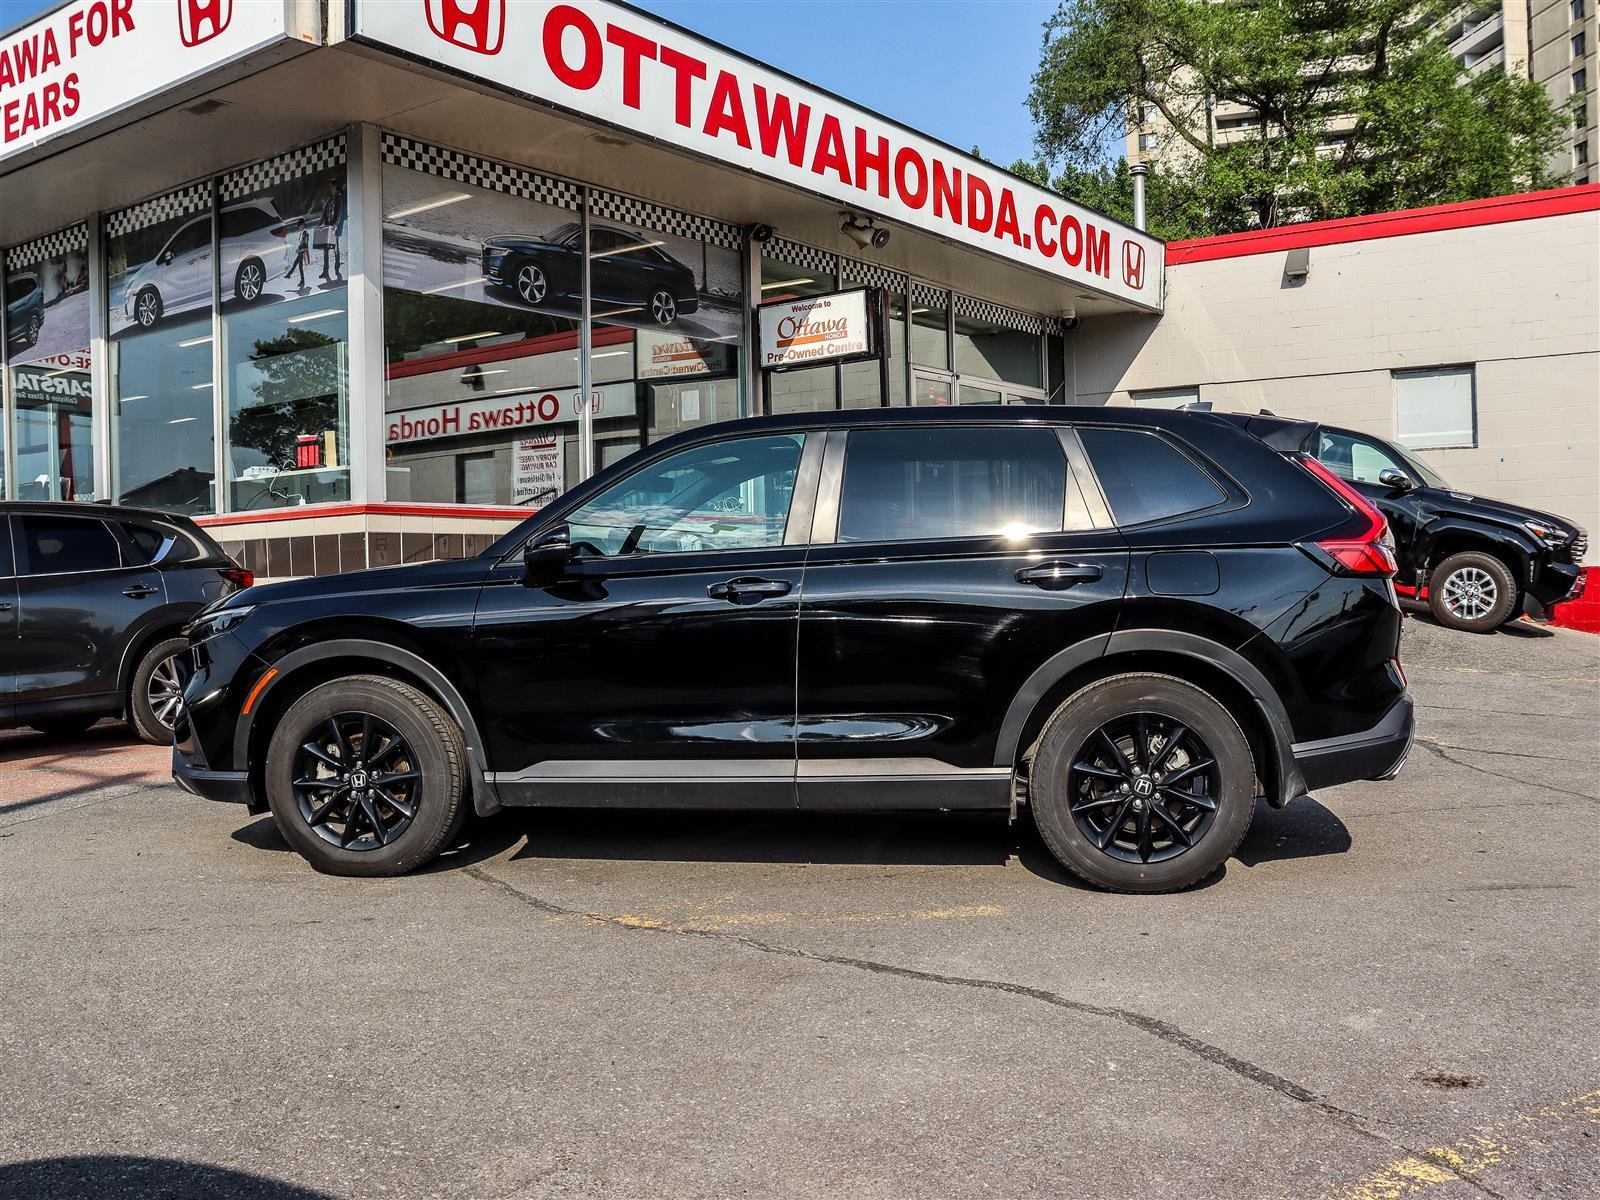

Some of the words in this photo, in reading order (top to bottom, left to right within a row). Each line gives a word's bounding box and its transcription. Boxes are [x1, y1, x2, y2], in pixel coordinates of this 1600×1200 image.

[68, 0, 136, 59] FOR
[0, 72, 80, 143] EARS
[542, 4, 1111, 280] OTTAWAHONDA.COM
[791, 302, 823, 312] Welcome
[824, 300, 831, 308] to
[777, 316, 848, 339] Ottawa
[767, 345, 824, 363] Pre-Owned
[827, 342, 863, 353] Centre
